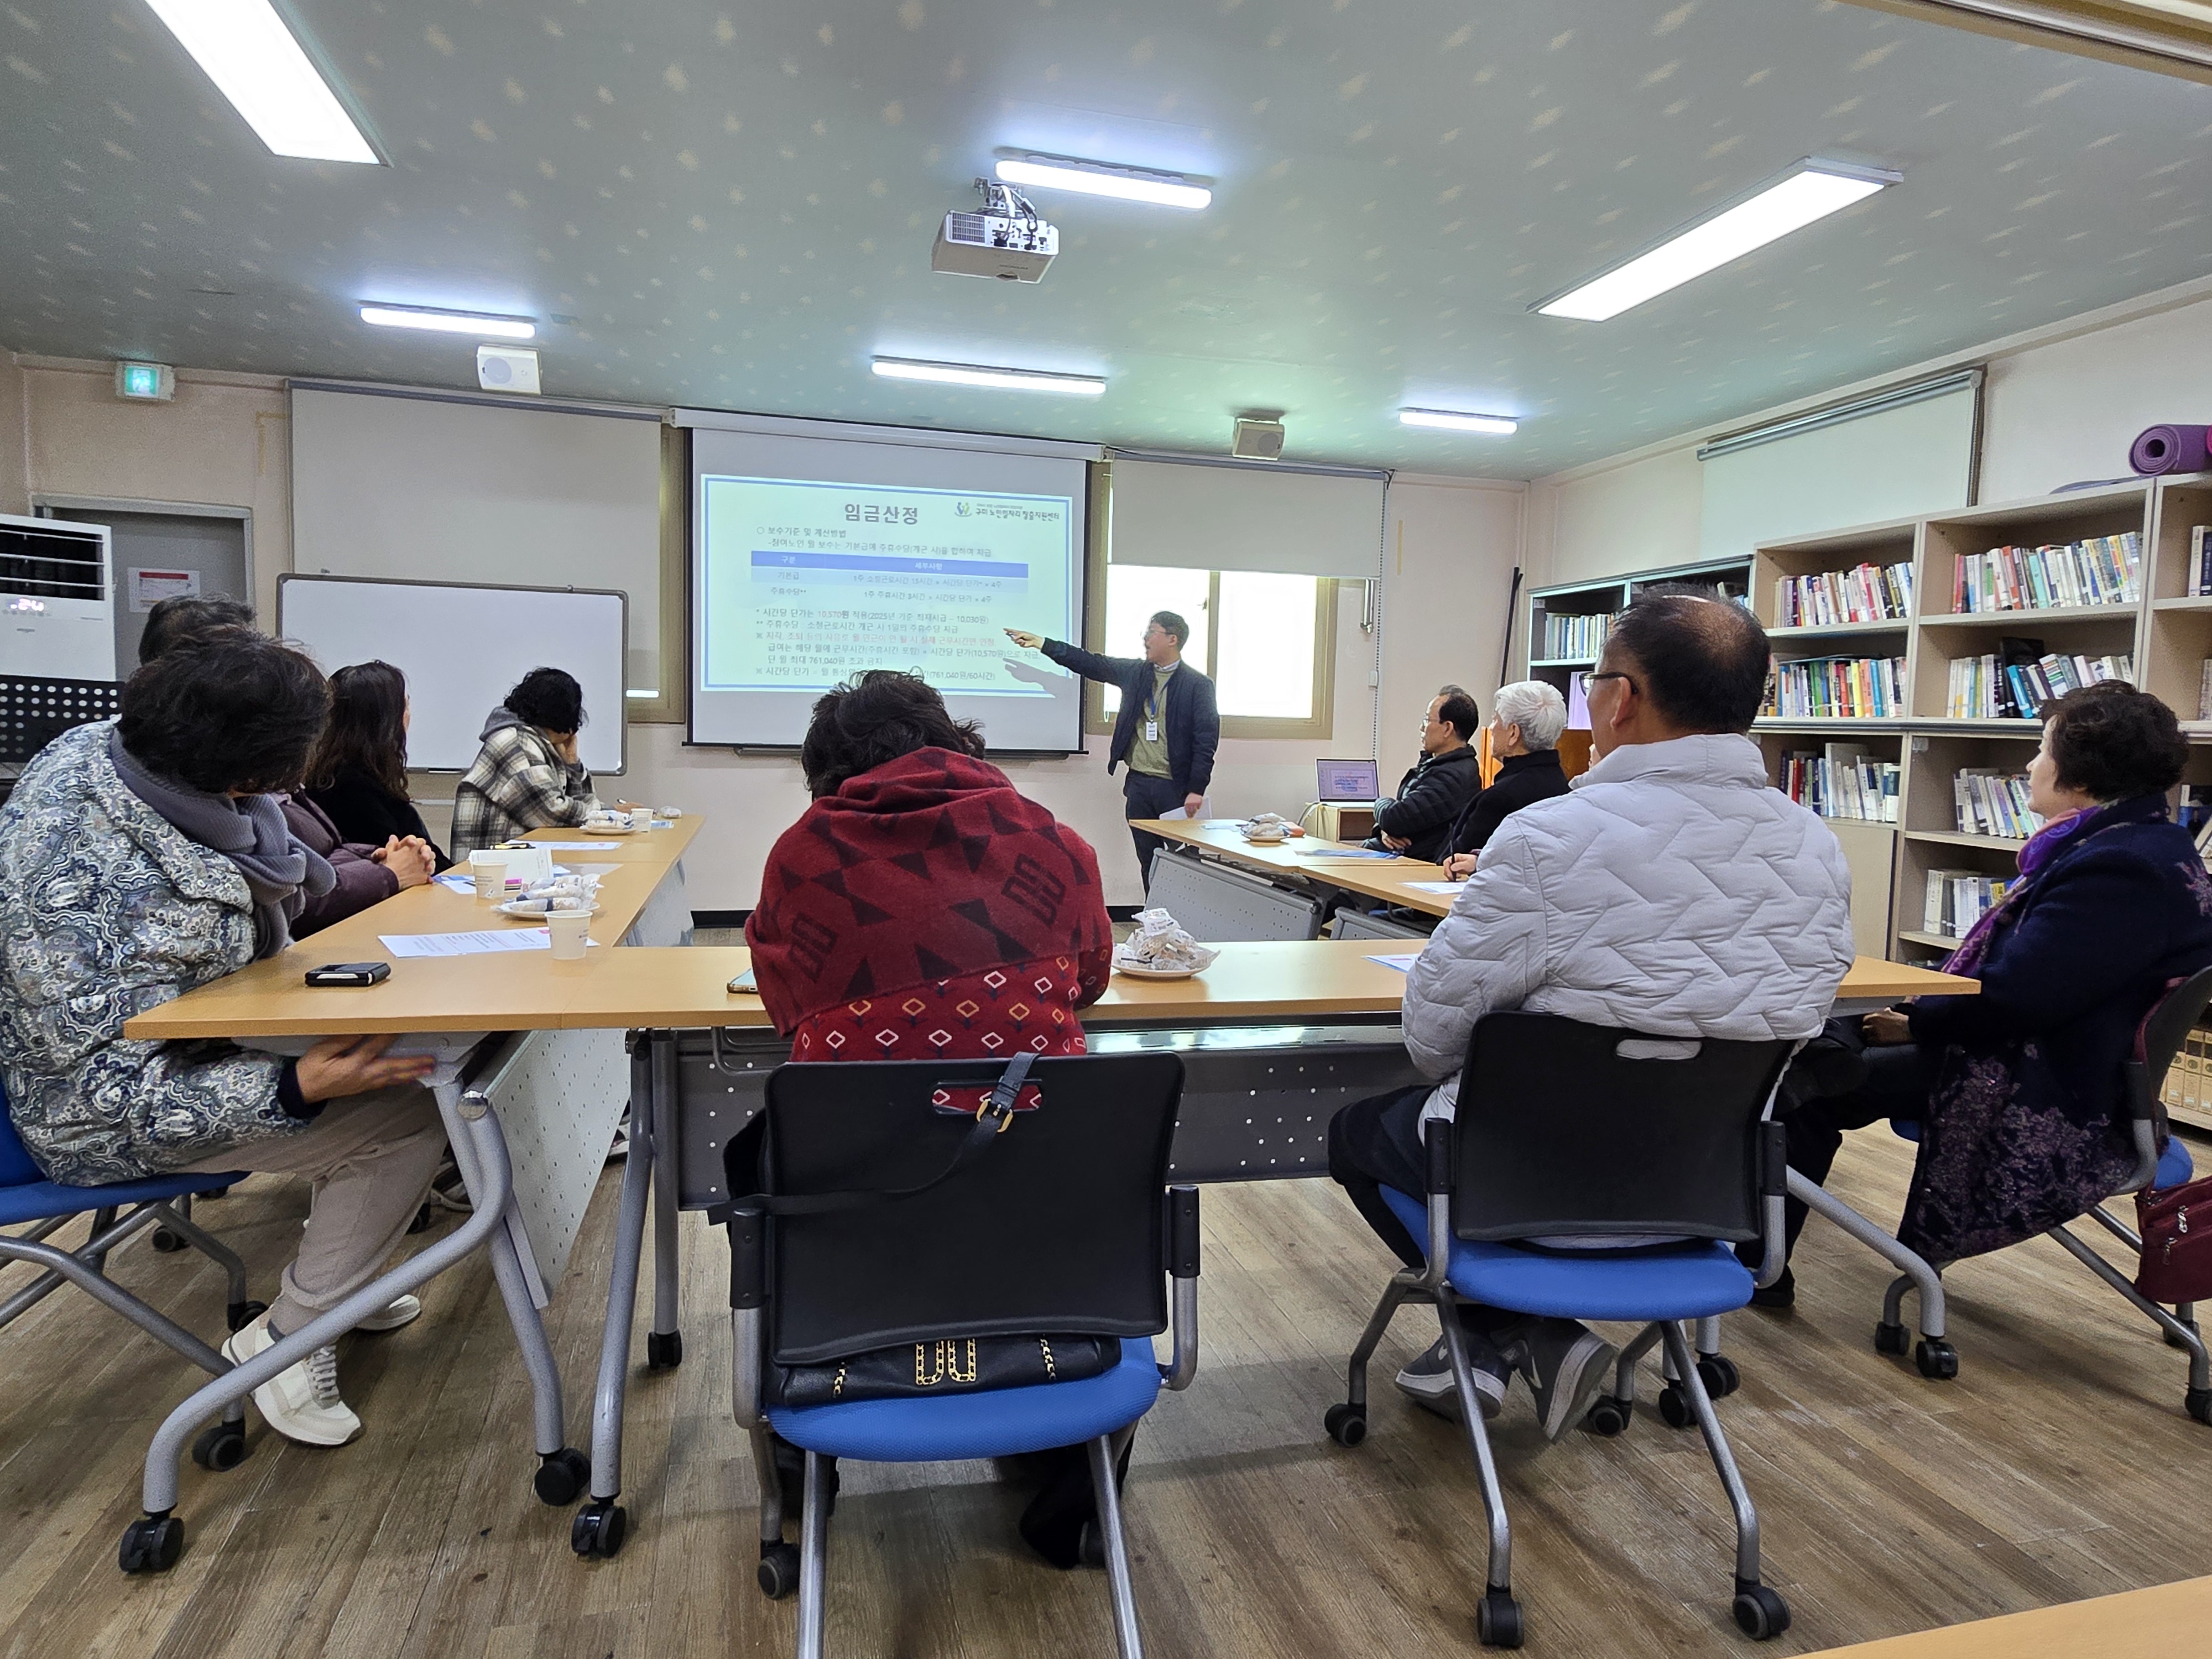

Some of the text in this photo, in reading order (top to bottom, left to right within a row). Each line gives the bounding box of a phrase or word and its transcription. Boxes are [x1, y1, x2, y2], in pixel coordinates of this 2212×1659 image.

[845, 504, 918, 525] 임금산정
[768, 527, 846, 538] 보수기준 및 계산방법
[818, 541, 842, 550] 보수는
[846, 542, 876, 551] 기본급에
[977, 549, 991, 557] 지급
[778, 572, 799, 580] 기본급
[878, 591, 905, 600] 주휴시간
[763, 608, 787, 617] 시간당
[791, 609, 814, 618] 단가는
[818, 611, 849, 619] 10,570원
[899, 613, 913, 621] 기준
[766, 620, 799, 629] 주휴수당
[769, 643, 792, 651] 급여는
[796, 644, 811, 652] 해당
[815, 644, 830, 653] 월에
[931, 648, 952, 656] 시간당
[769, 655, 775, 664] 단
[780, 655, 786, 664] 월
[791, 656, 806, 664] 최대
[810, 656, 845, 665] 761,040원
[867, 657, 882, 665] 금지
[766, 667, 790, 675] 시간당
